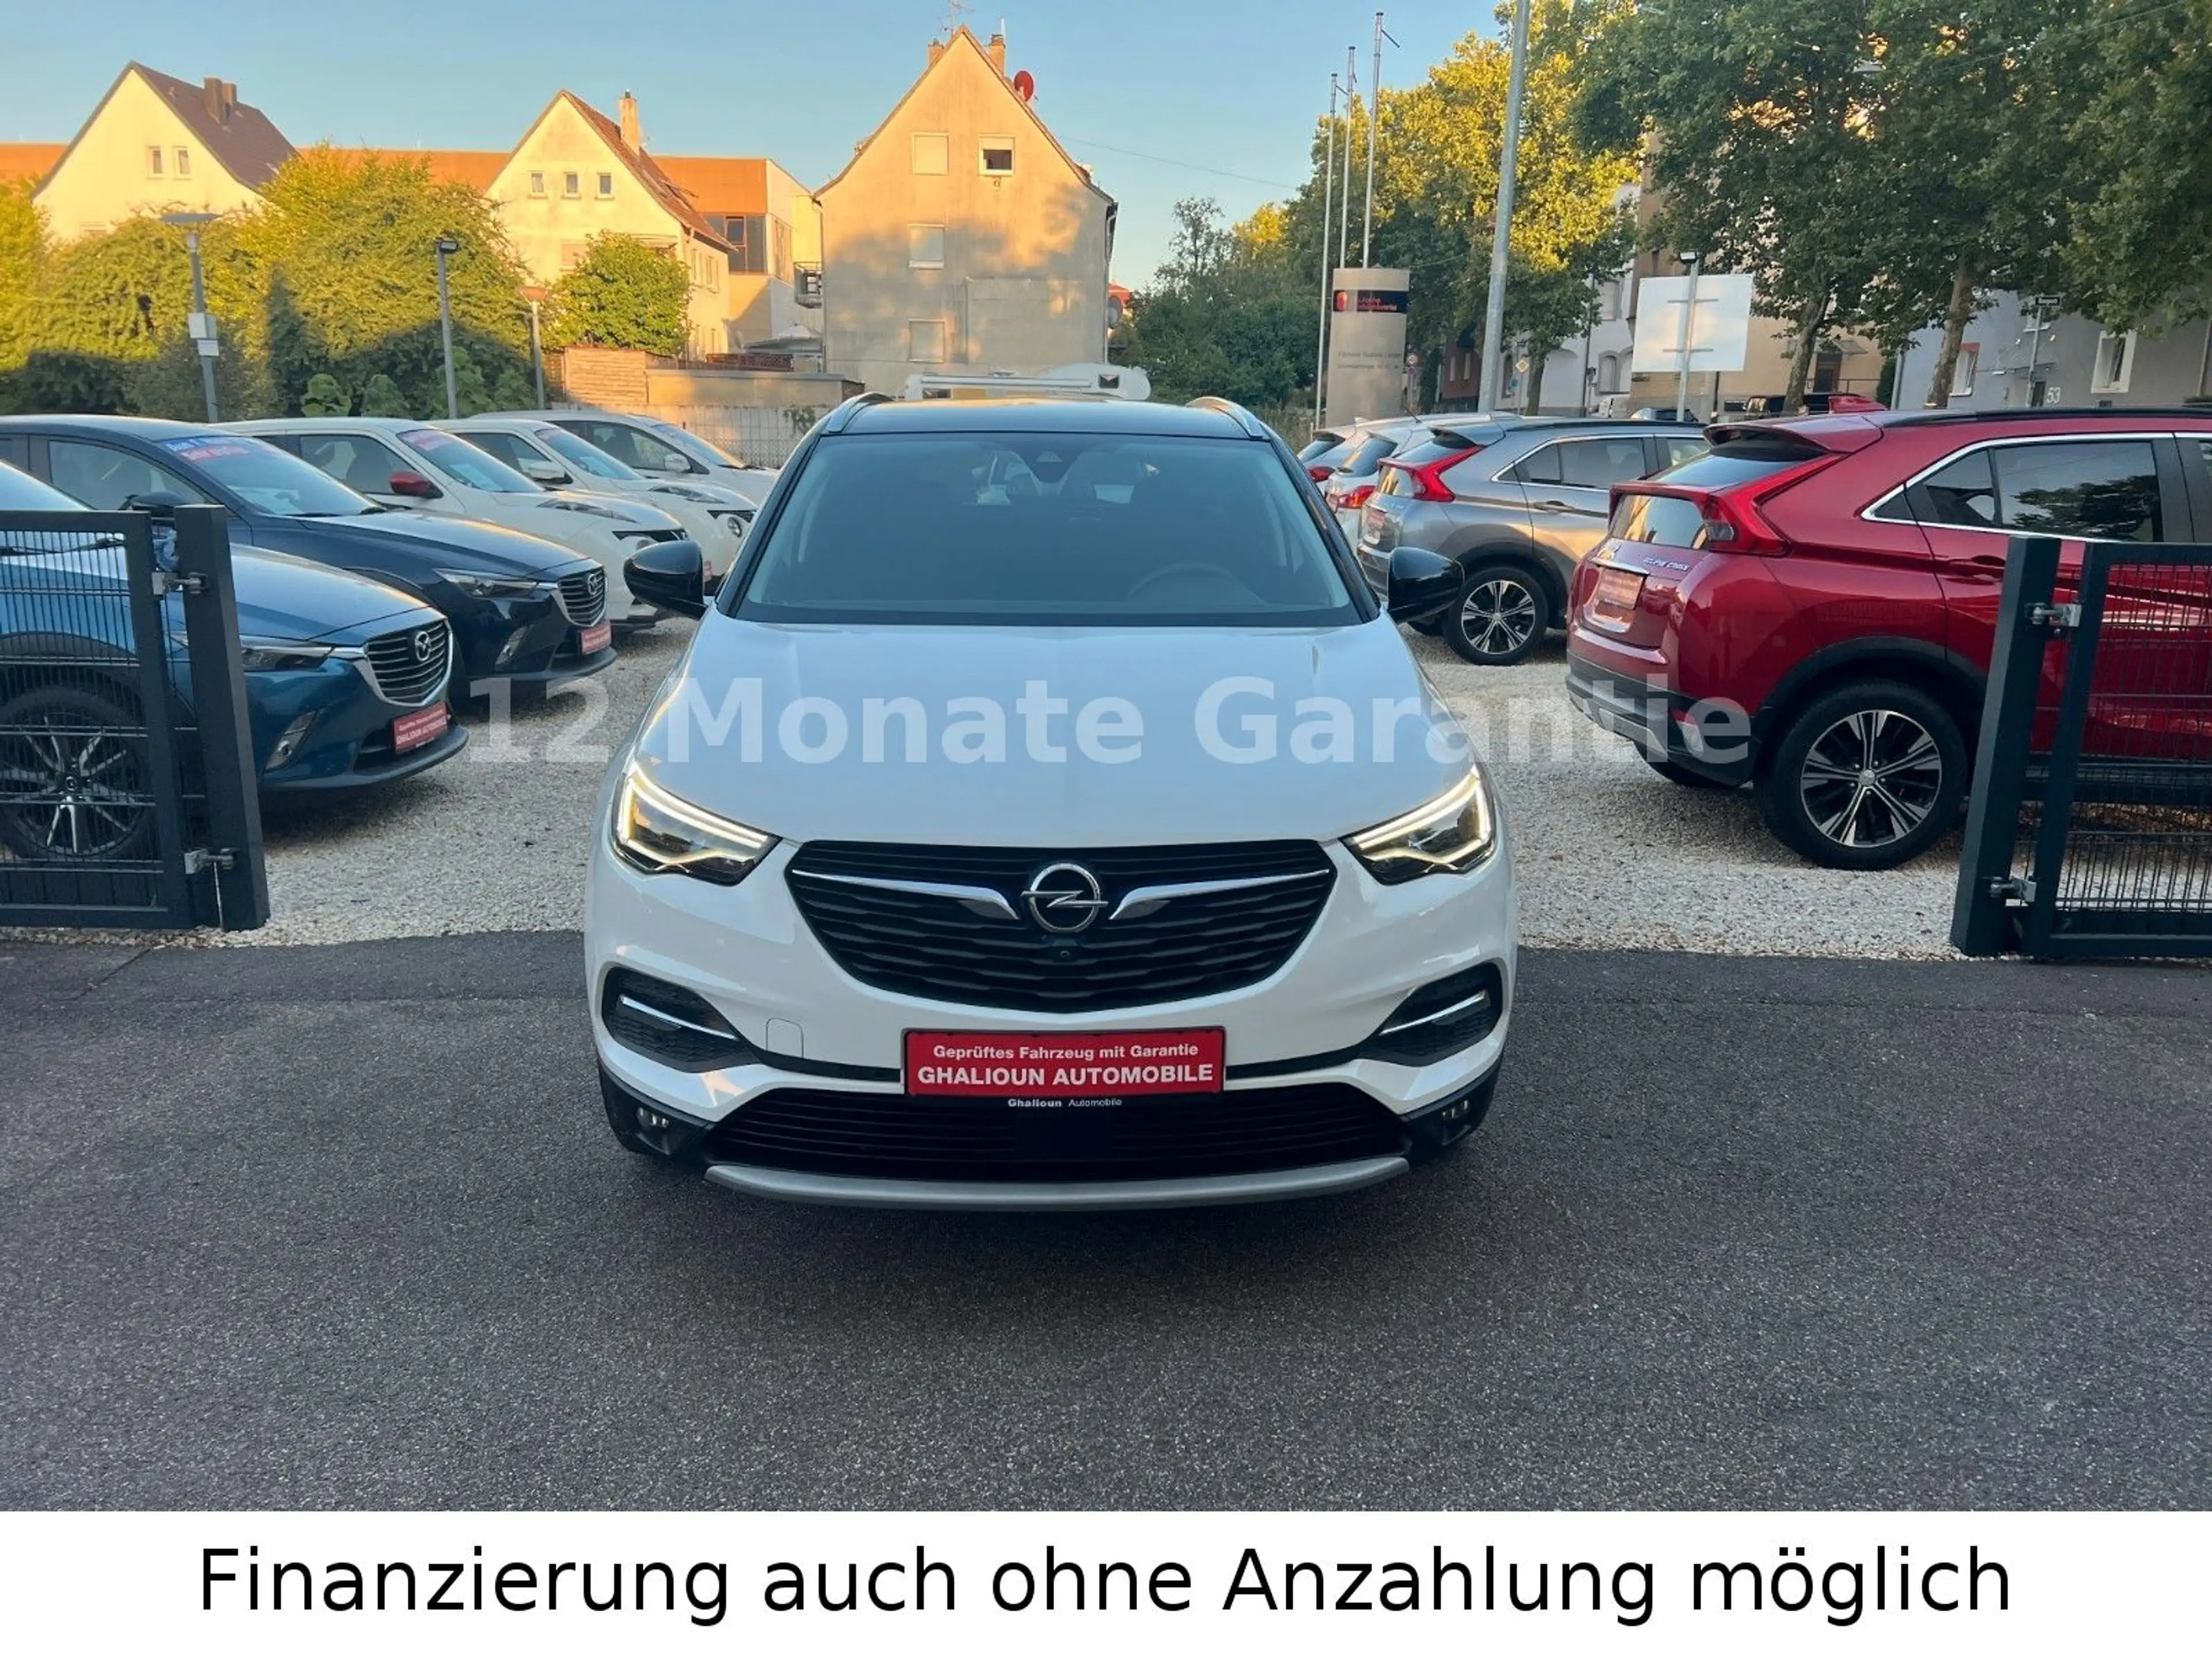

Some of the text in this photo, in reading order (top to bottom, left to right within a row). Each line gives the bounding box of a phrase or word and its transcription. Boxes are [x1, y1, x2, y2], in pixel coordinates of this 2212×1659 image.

[2046, 387, 2061, 403] 53
[933, 1043, 1199, 1061] Geprüftes Fahrzeug mit Garantie
[917, 1063, 1213, 1086] GHALIOUN AUTOMOBILE
[1007, 1097, 1122, 1107] Ghalioun Automobile
